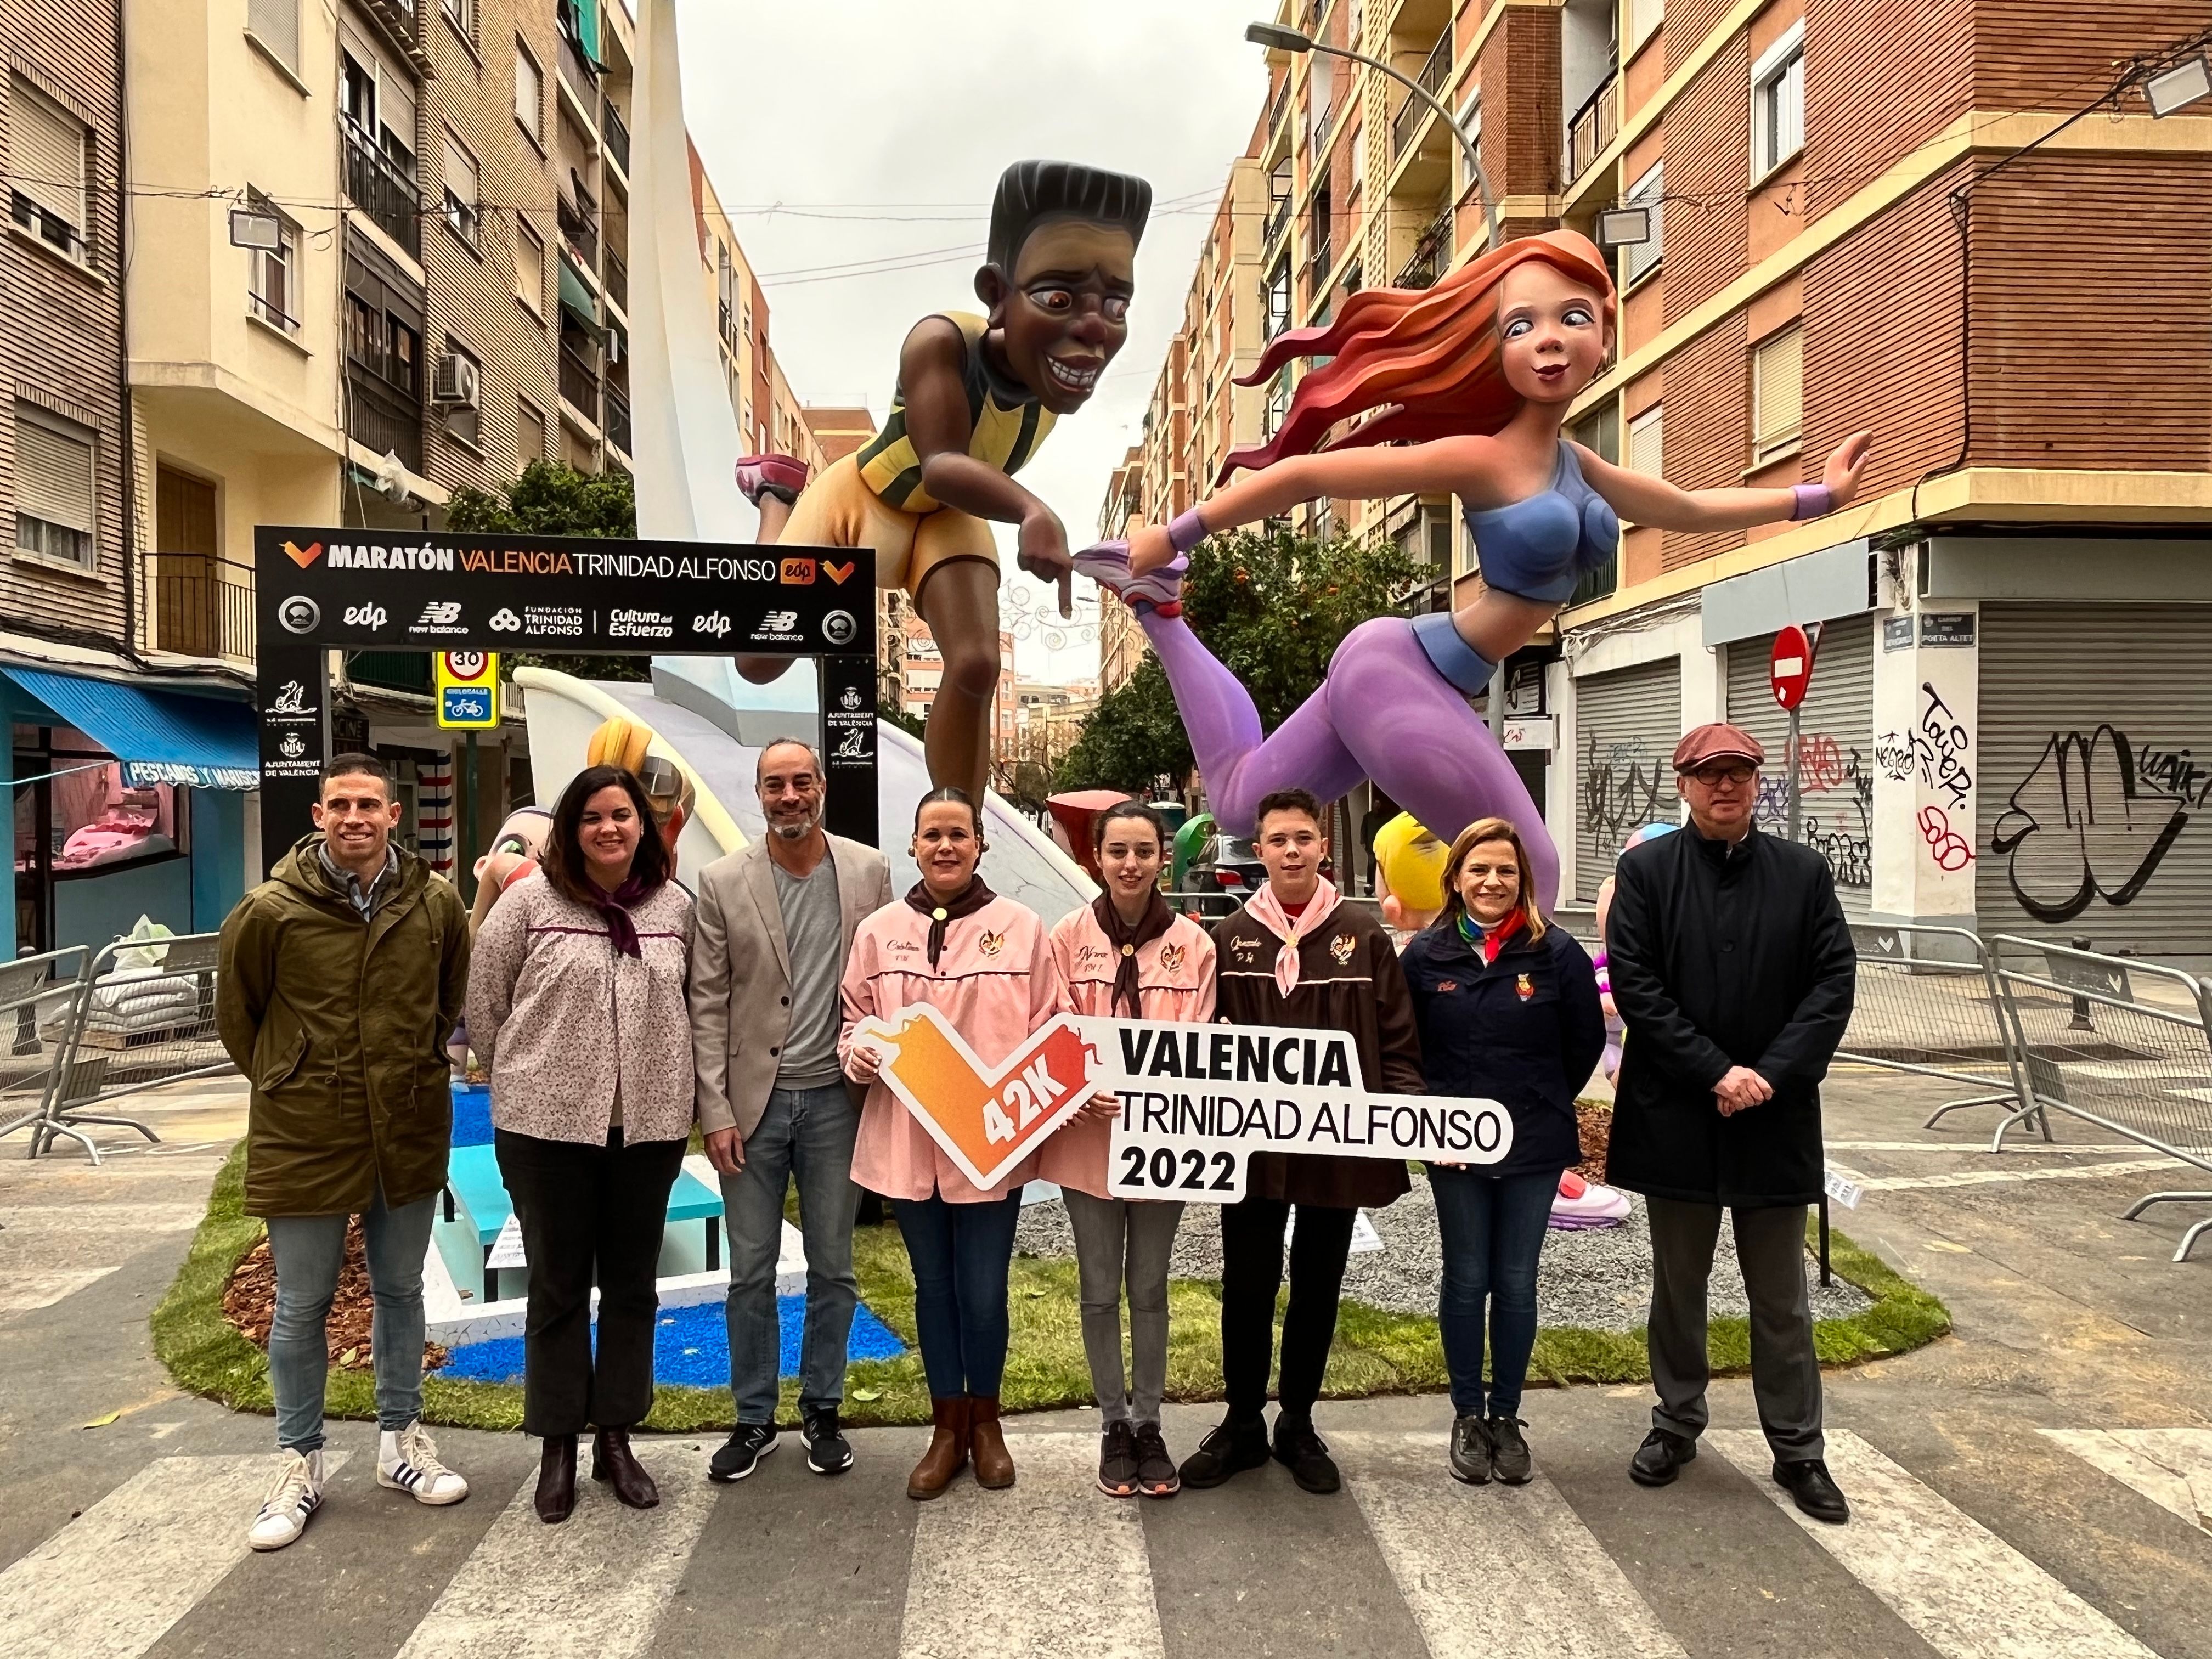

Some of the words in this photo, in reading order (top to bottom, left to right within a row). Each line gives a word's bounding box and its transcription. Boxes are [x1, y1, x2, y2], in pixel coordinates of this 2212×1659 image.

[329, 542, 454, 571] MARATÓN
[459, 549, 573, 574] VALENCIA
[573, 553, 673, 578] TRINIDAD
[677, 557, 775, 581] ALFONSO
[785, 562, 810, 582] edp
[343, 602, 387, 631] edp
[524, 614, 582, 625] TRINIDAD
[611, 609, 660, 623] Cultura
[692, 610, 732, 639] edp
[409, 625, 428, 634] new
[430, 625, 469, 635] balance
[525, 625, 583, 635] ALFONSO
[609, 622, 673, 637] Esfuerzo
[454, 651, 479, 667] 30
[129, 761, 200, 783] PESCADOS
[1119, 1028, 1352, 1088] VALENCIA
[983, 1053, 1068, 1146] 42K
[1114, 1090, 1302, 1140] TRINIDAD
[1307, 1102, 1502, 1153] ALFONSO
[1118, 1146, 1235, 1192] 2022
